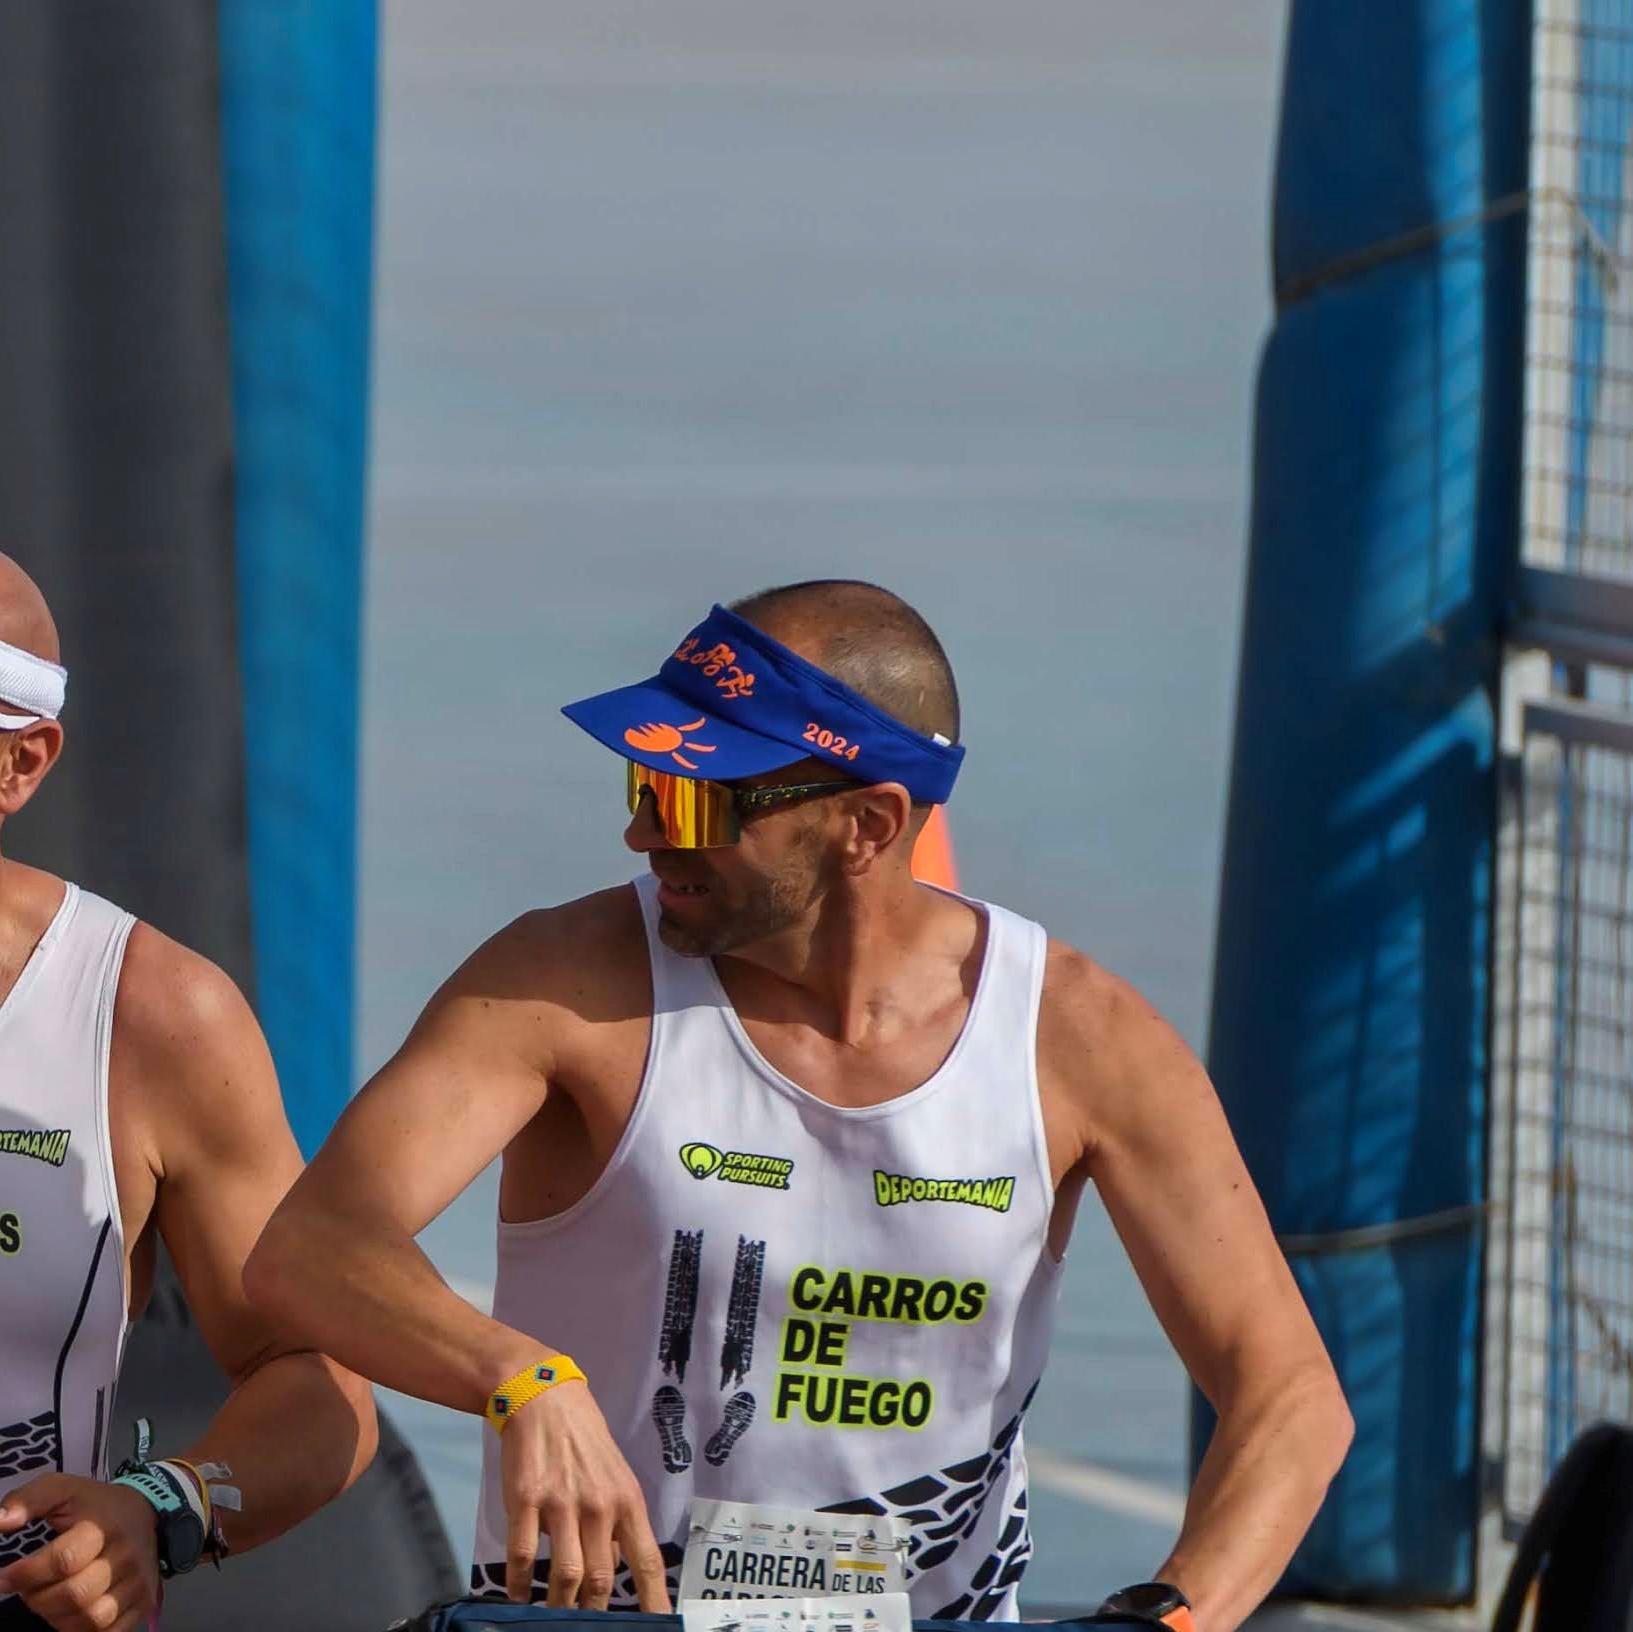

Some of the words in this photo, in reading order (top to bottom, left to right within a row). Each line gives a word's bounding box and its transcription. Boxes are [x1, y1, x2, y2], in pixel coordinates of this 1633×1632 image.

[802, 723, 860, 760] 2024
[723, 1152, 794, 1174] SPORTING
[873, 1169, 1016, 1213] DEPORTEMANIA
[792, 1268, 987, 1322] CARROS
[783, 1318, 849, 1366] DE
[776, 1373, 932, 1427] FUEGO
[704, 1547, 826, 1591] CARRERA
[831, 1573, 851, 1593] DE
[856, 1574, 885, 1594] LAS
